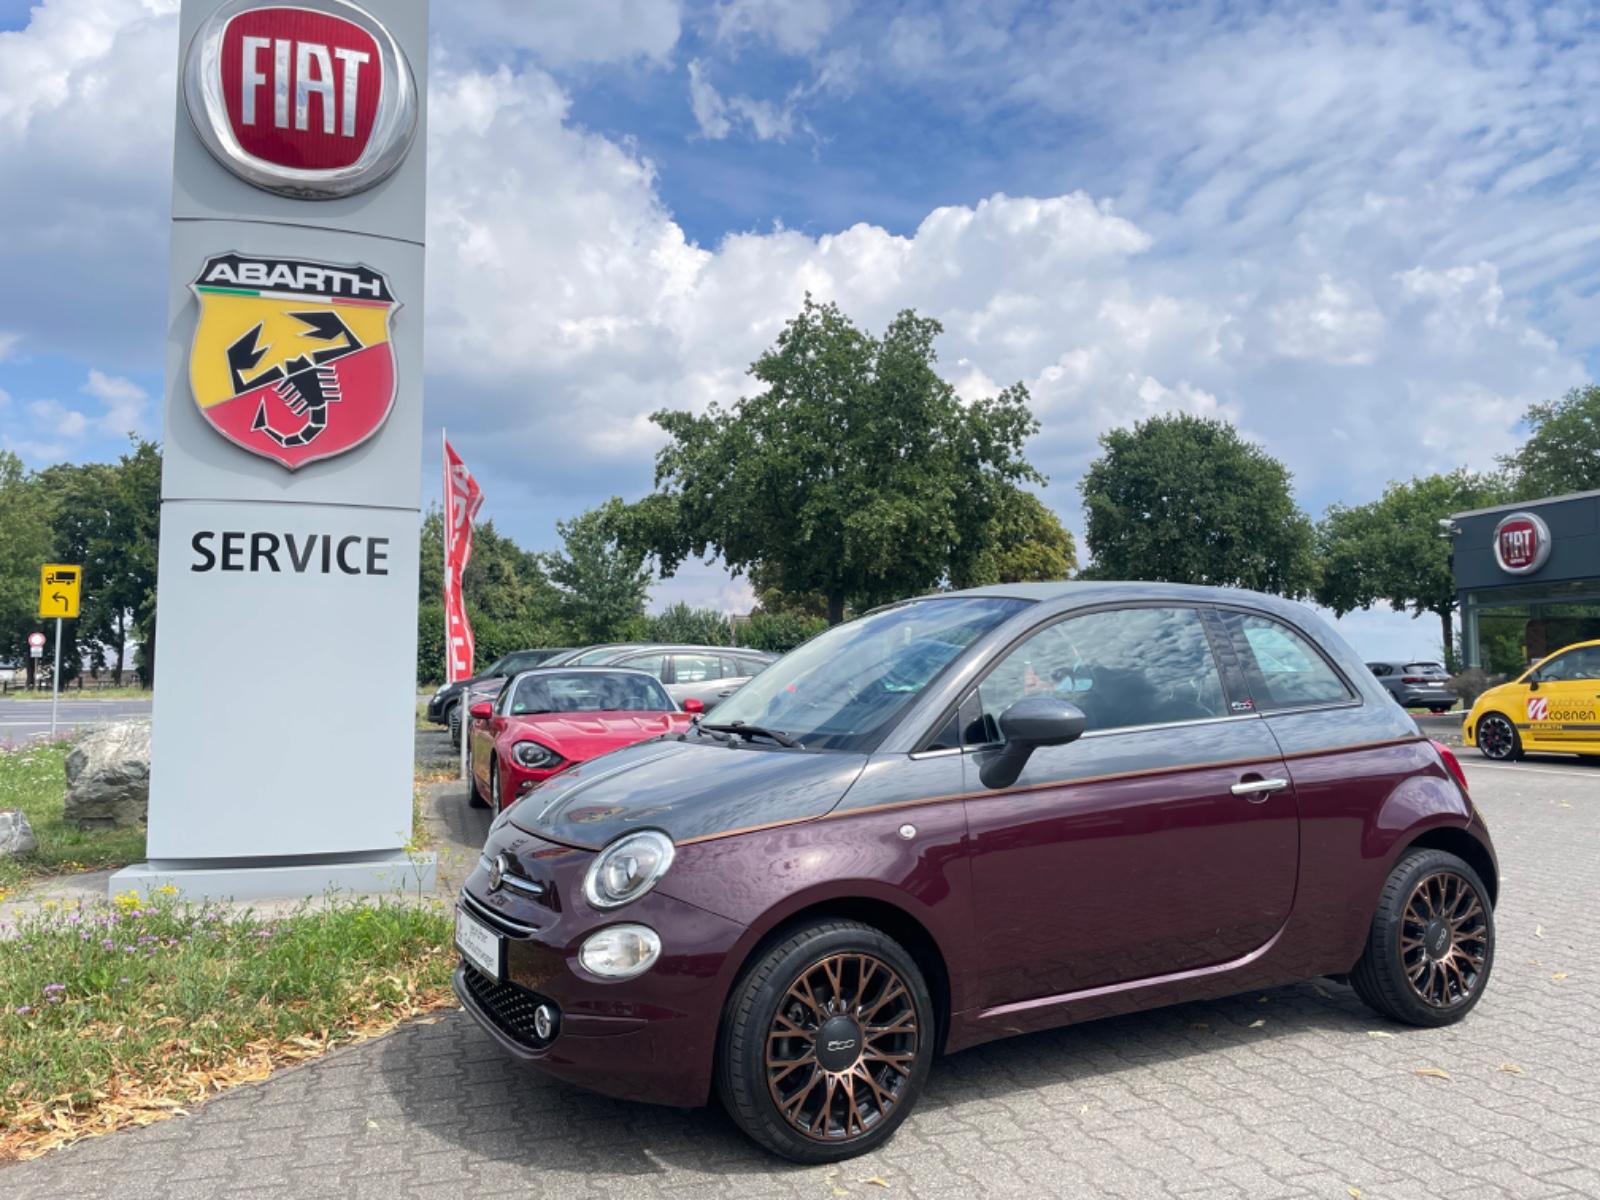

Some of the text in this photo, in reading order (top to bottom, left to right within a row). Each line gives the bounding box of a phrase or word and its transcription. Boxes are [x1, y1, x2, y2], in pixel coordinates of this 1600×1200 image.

[242, 35, 370, 137] FIAT
[204, 262, 381, 297] ABARTH
[190, 530, 390, 576] SERVICE
[1502, 528, 1532, 559] FIAT
[1548, 710, 1596, 721] coenen
